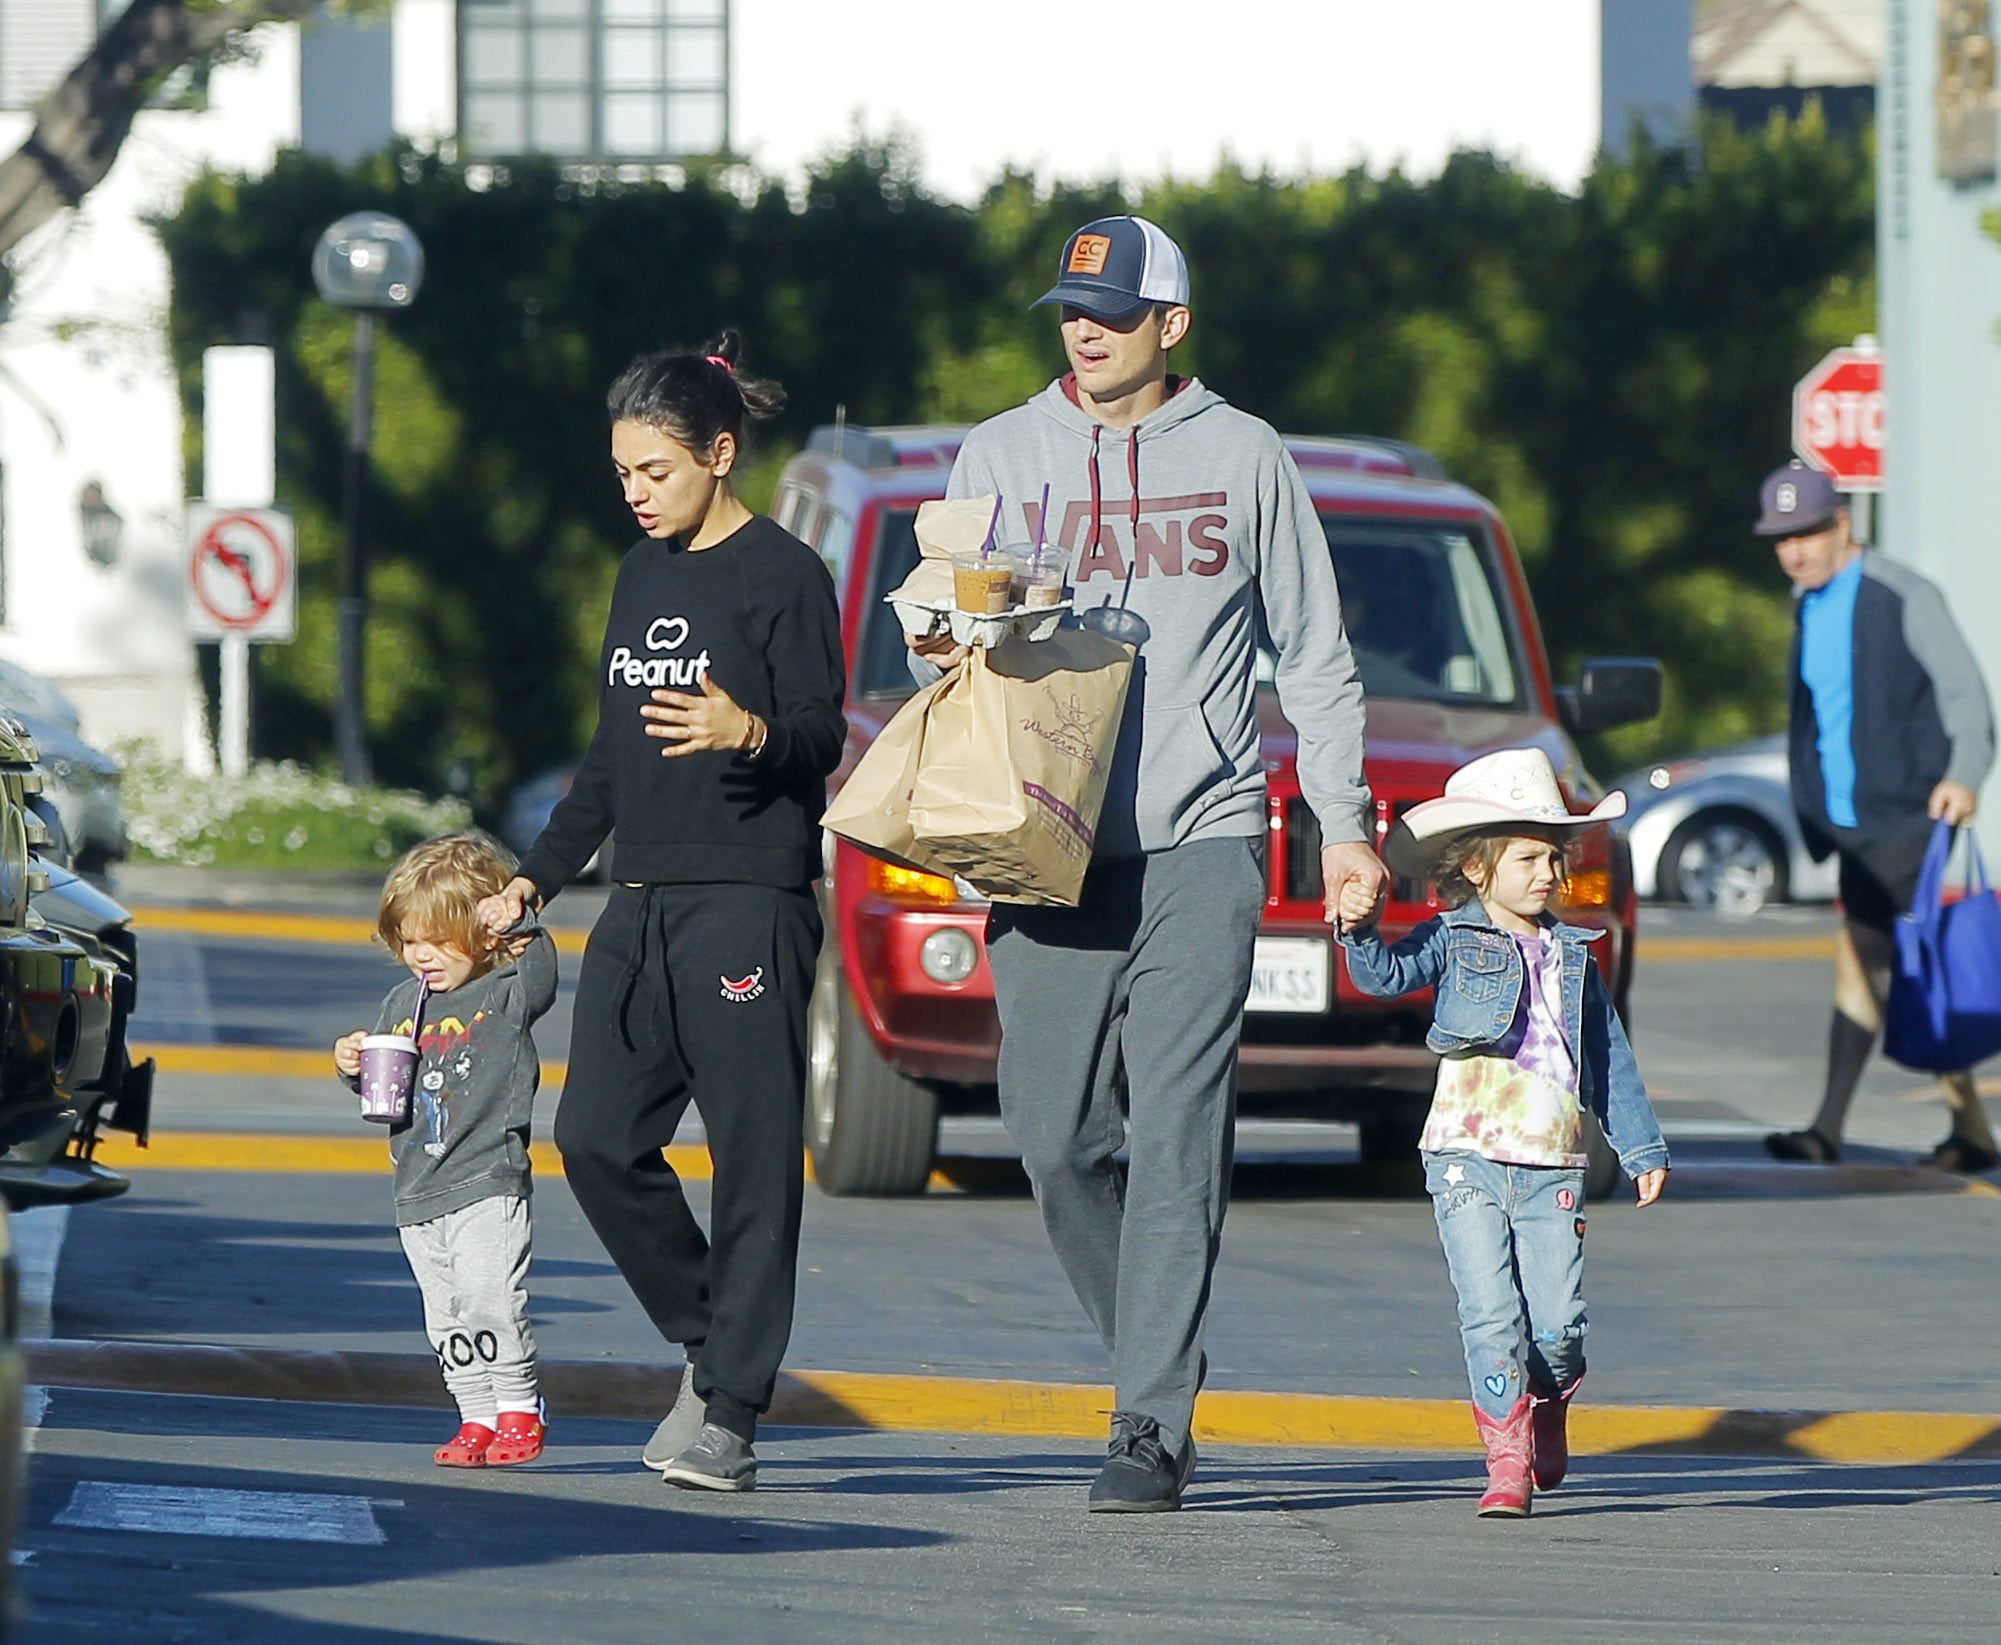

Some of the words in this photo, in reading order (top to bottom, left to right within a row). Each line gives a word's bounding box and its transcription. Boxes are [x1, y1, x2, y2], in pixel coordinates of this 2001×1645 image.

[1810, 390, 1888, 449] STO
[1022, 491, 1229, 582] VANS
[608, 647, 711, 687] Peanut
[1020, 719, 1079, 755] Western
